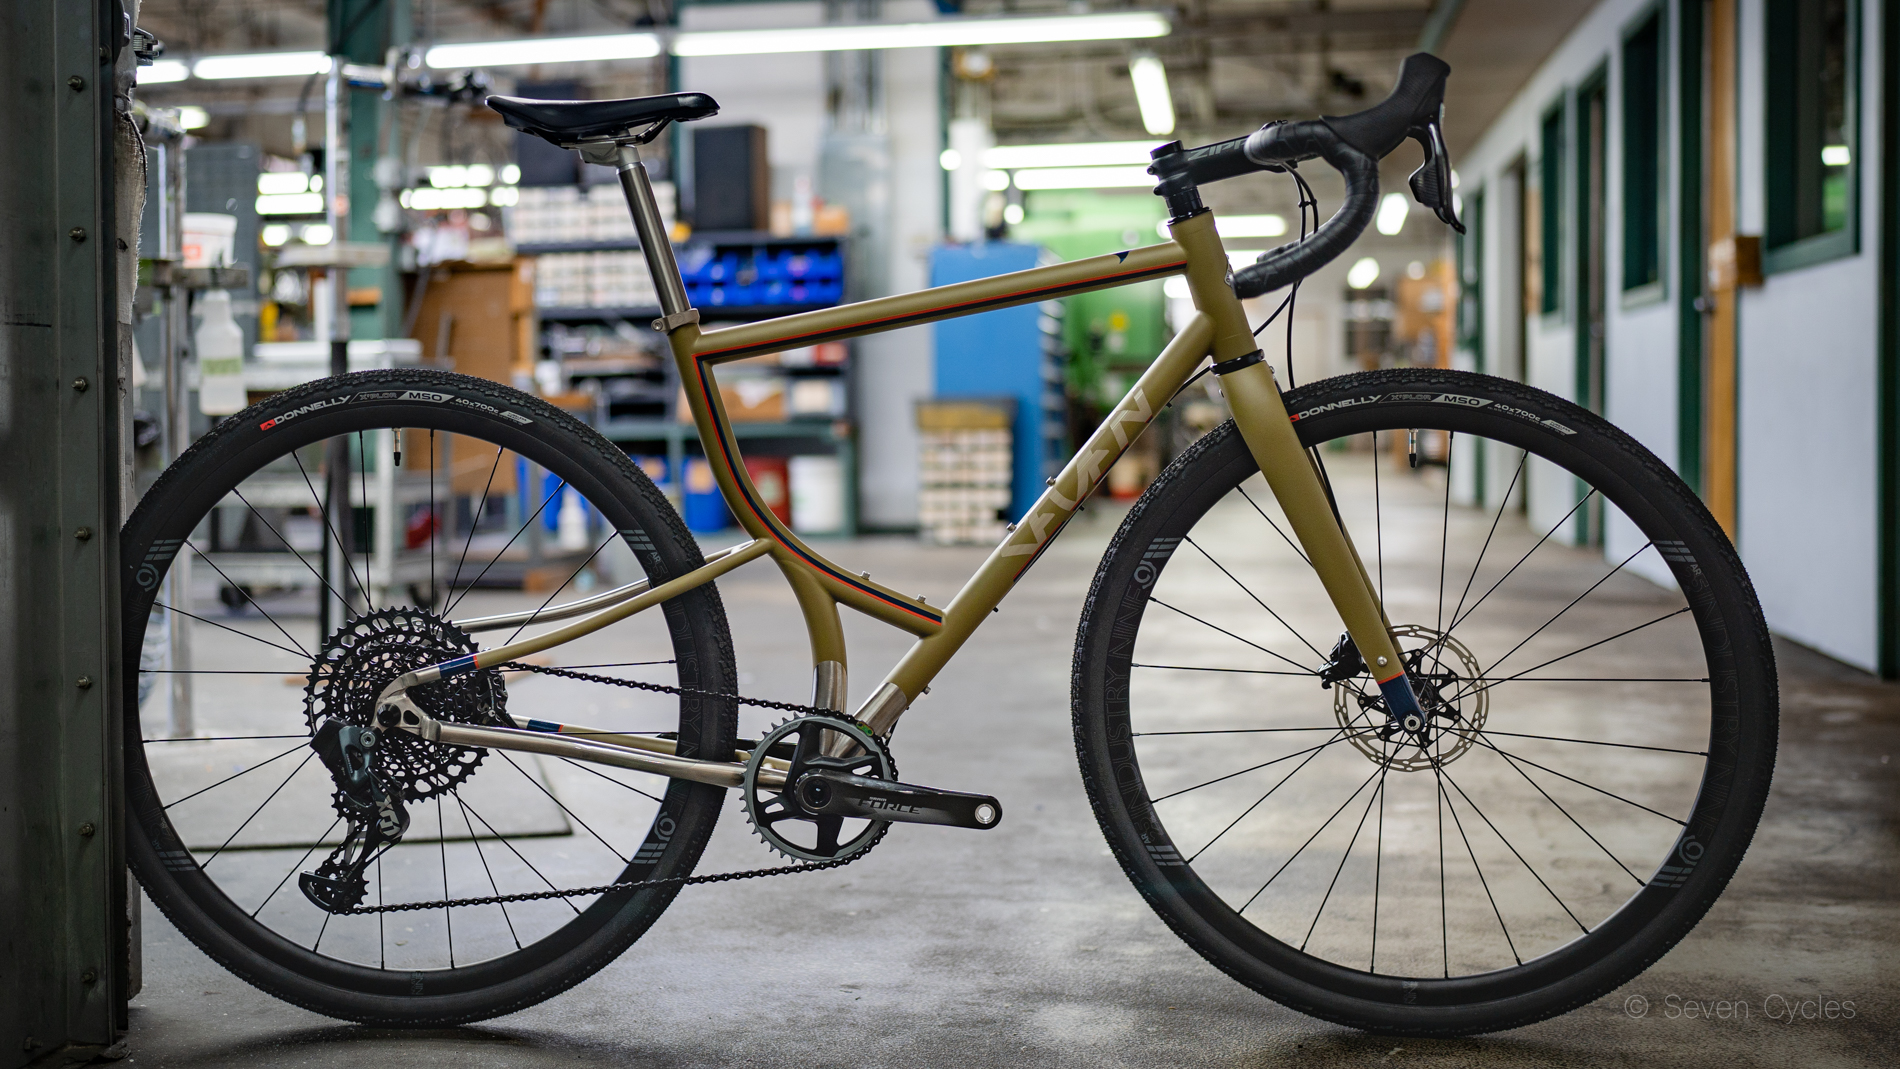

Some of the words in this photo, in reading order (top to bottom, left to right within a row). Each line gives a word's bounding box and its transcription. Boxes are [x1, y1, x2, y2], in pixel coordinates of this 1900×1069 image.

[273, 395, 352, 425] DONNELLY
[409, 392, 442, 401] MSO
[455, 397, 500, 414] 40x700c
[1299, 395, 1382, 420] DONNELLY
[1444, 395, 1481, 405] MSO
[1494, 403, 1541, 422] 40x700c
[1108, 584, 1149, 660] NINE
[1103, 664, 1151, 819] INDUSTRY
[858, 798, 920, 815] FORCE
